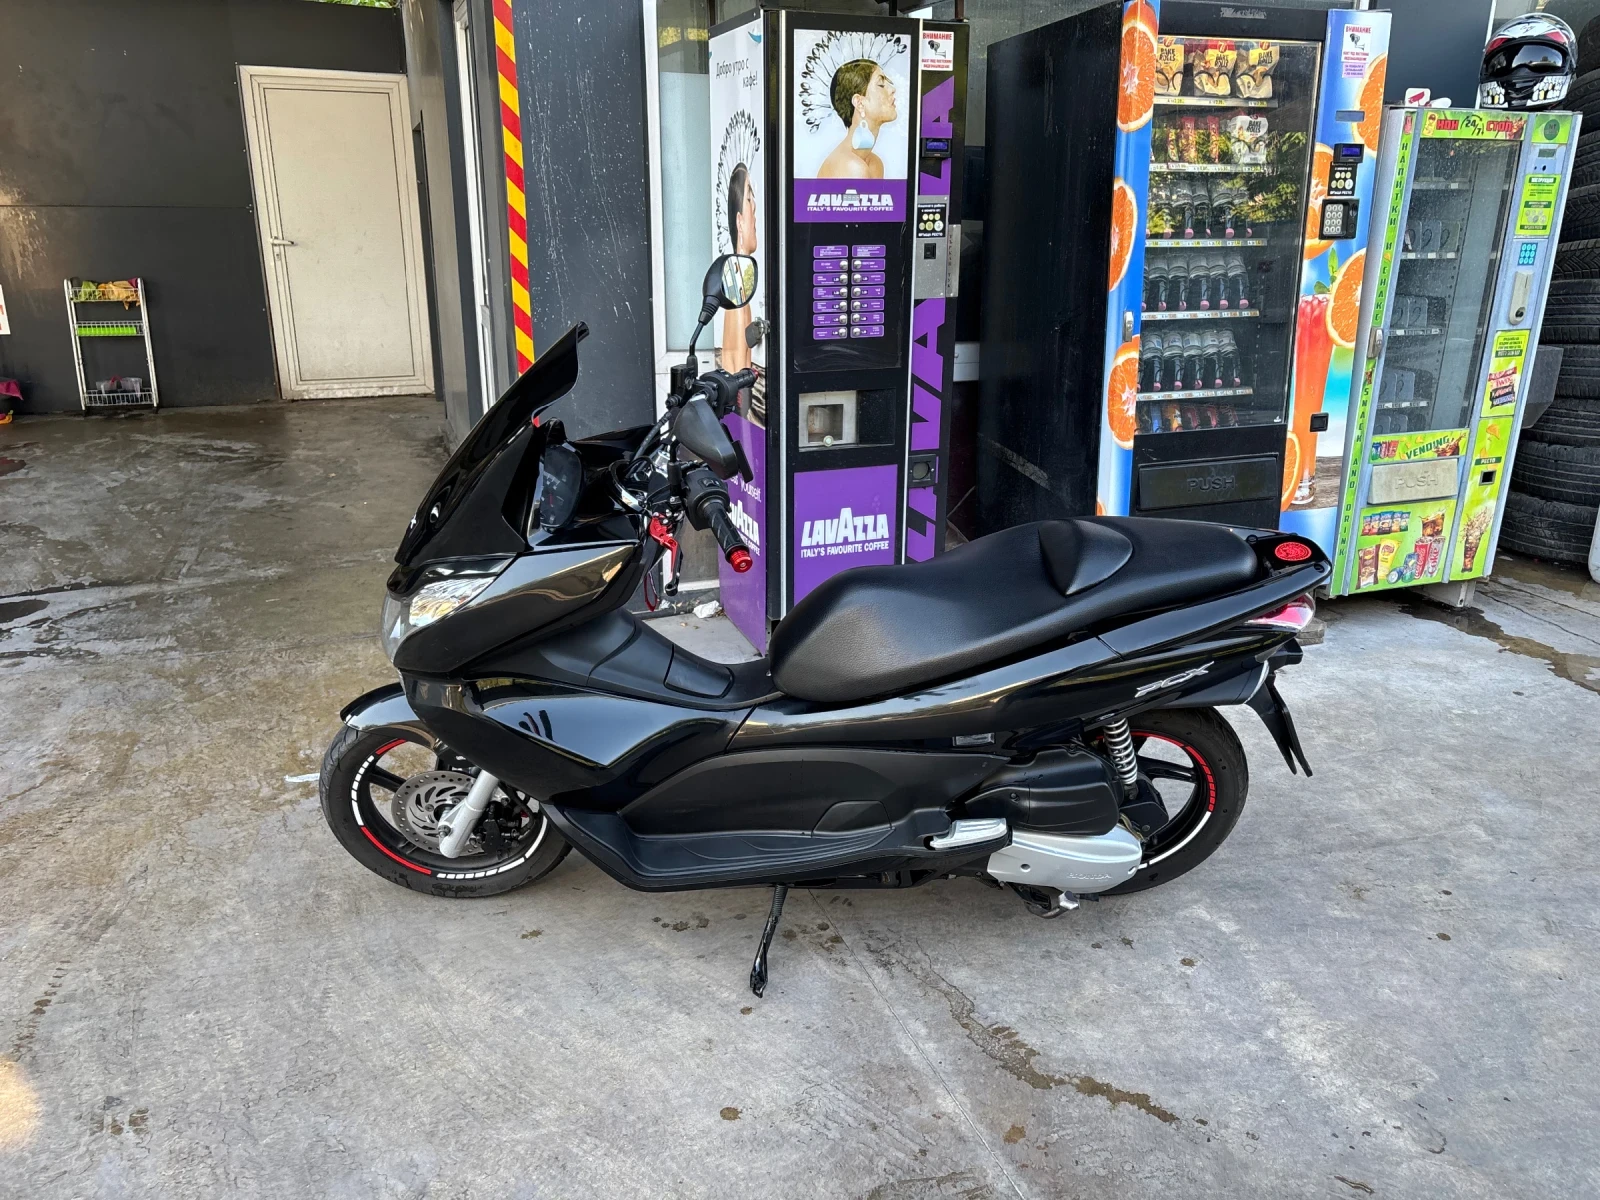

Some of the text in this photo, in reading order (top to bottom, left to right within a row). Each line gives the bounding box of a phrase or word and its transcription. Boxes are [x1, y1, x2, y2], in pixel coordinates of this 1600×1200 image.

[922, 32, 952, 40] ВНИМАНИЕ
[716, 60, 732, 79] Добро
[743, 70, 758, 91] кафе!
[1436, 119, 1459, 131] НОН
[1486, 120, 1513, 132] СТОП
[807, 189, 894, 206] LAVAZZA
[1374, 142, 1408, 322] НАПИТКИ И СНАКС
[1406, 435, 1449, 460] VENDING
[1339, 387, 1369, 556] SNACK AND DRINK
[1187, 475, 1235, 493] PUSH
[1394, 474, 1438, 490] PUSH
[801, 507, 889, 548] LAVAZZA
[800, 540, 889, 559] ITALY'S FAVOURITE COFFEE
[1067, 872, 1113, 881] HONDA
